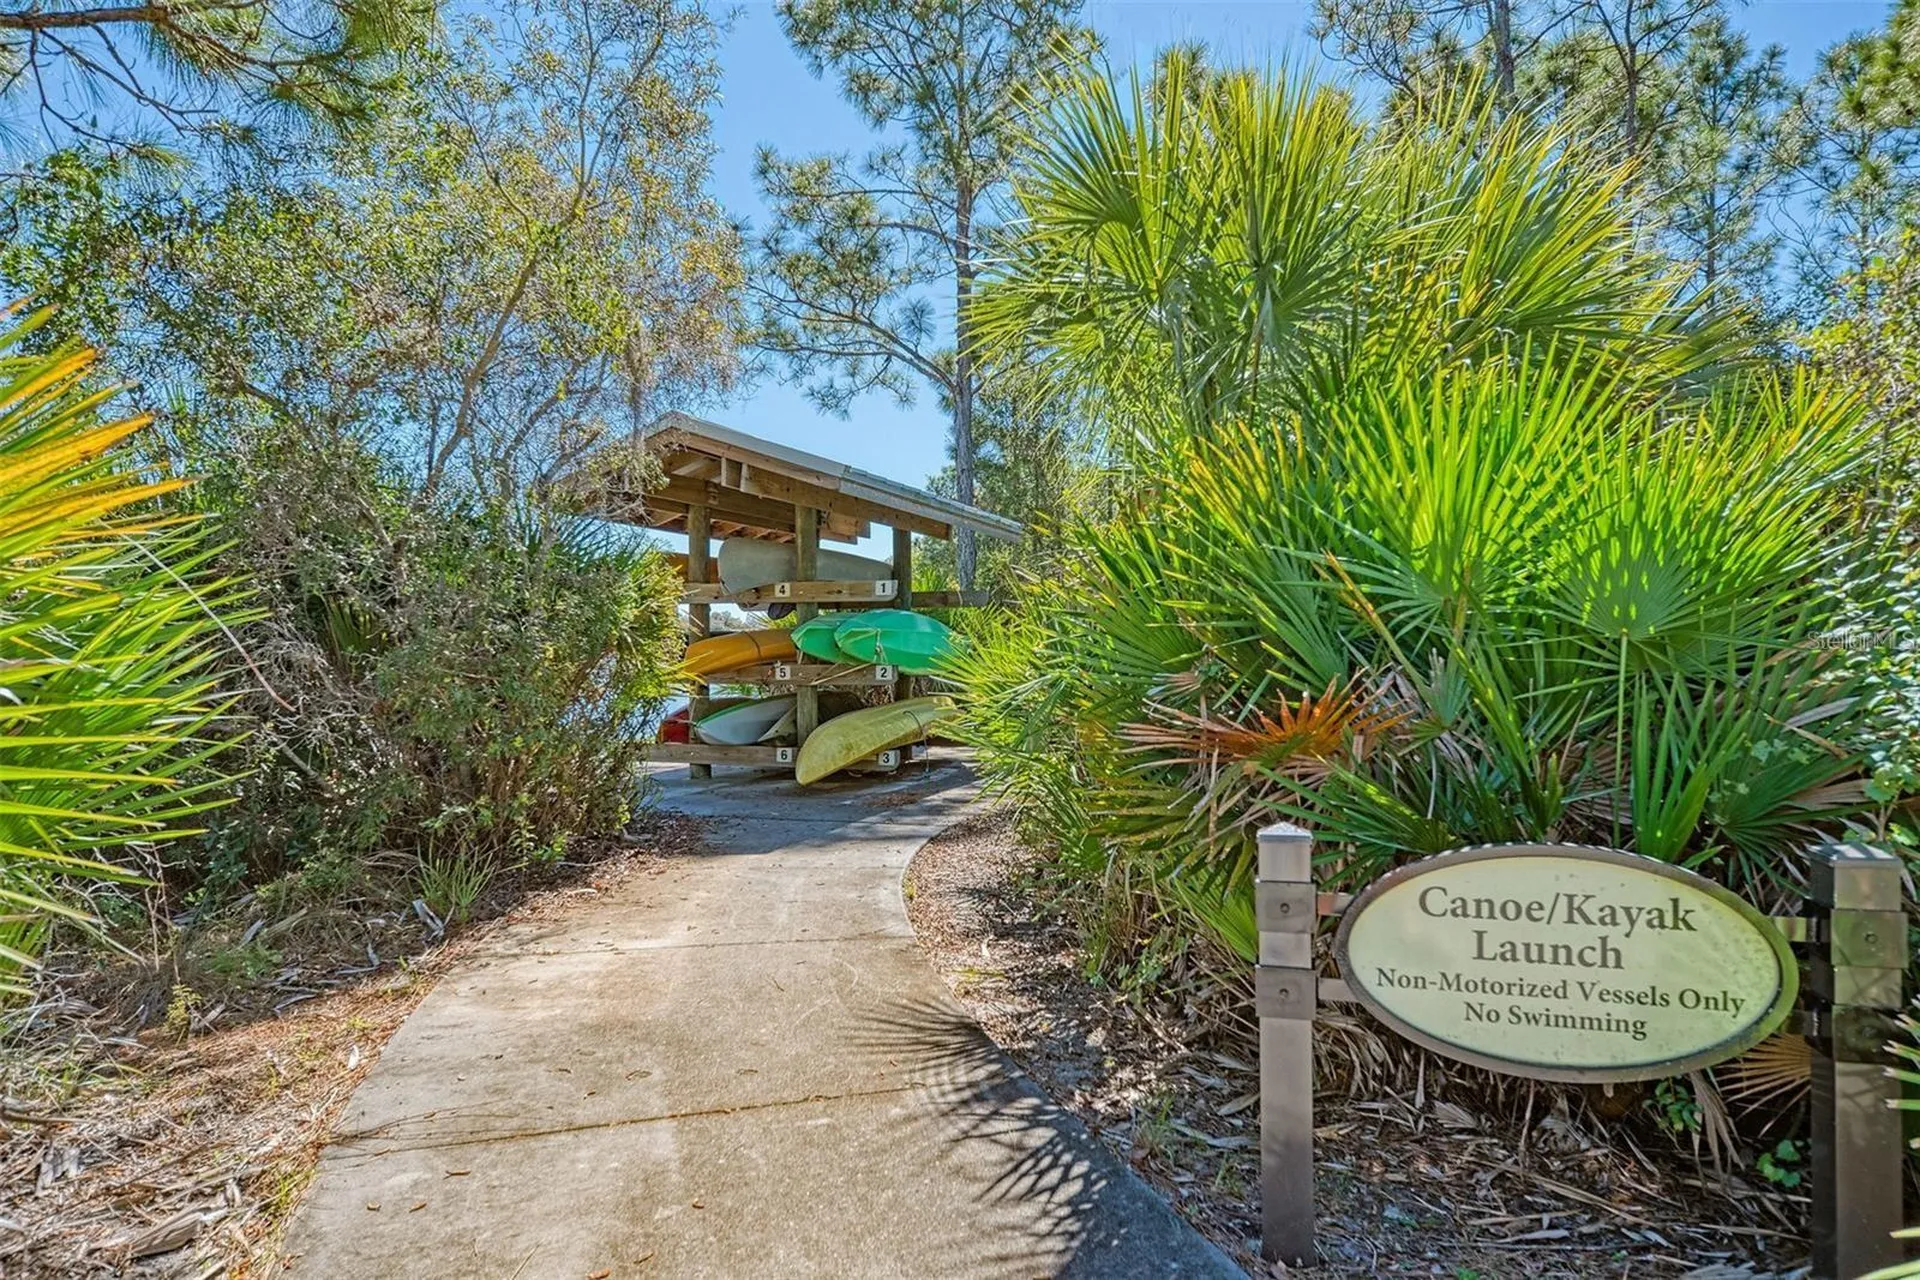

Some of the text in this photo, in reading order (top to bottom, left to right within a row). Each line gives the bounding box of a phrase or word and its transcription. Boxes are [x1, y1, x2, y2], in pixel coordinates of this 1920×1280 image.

[778, 584, 786, 596] 4
[779, 667, 787, 679] 5
[879, 666, 888, 679] 2
[780, 749, 789, 761] 6
[882, 752, 891, 764] 3
[1418, 885, 1698, 939] Canoe/Kayak
[1471, 929, 1625, 970] Launch
[1376, 967, 1747, 1018] Non-Motorized Vessels Only
[1464, 1002, 1648, 1040] No Swimming
